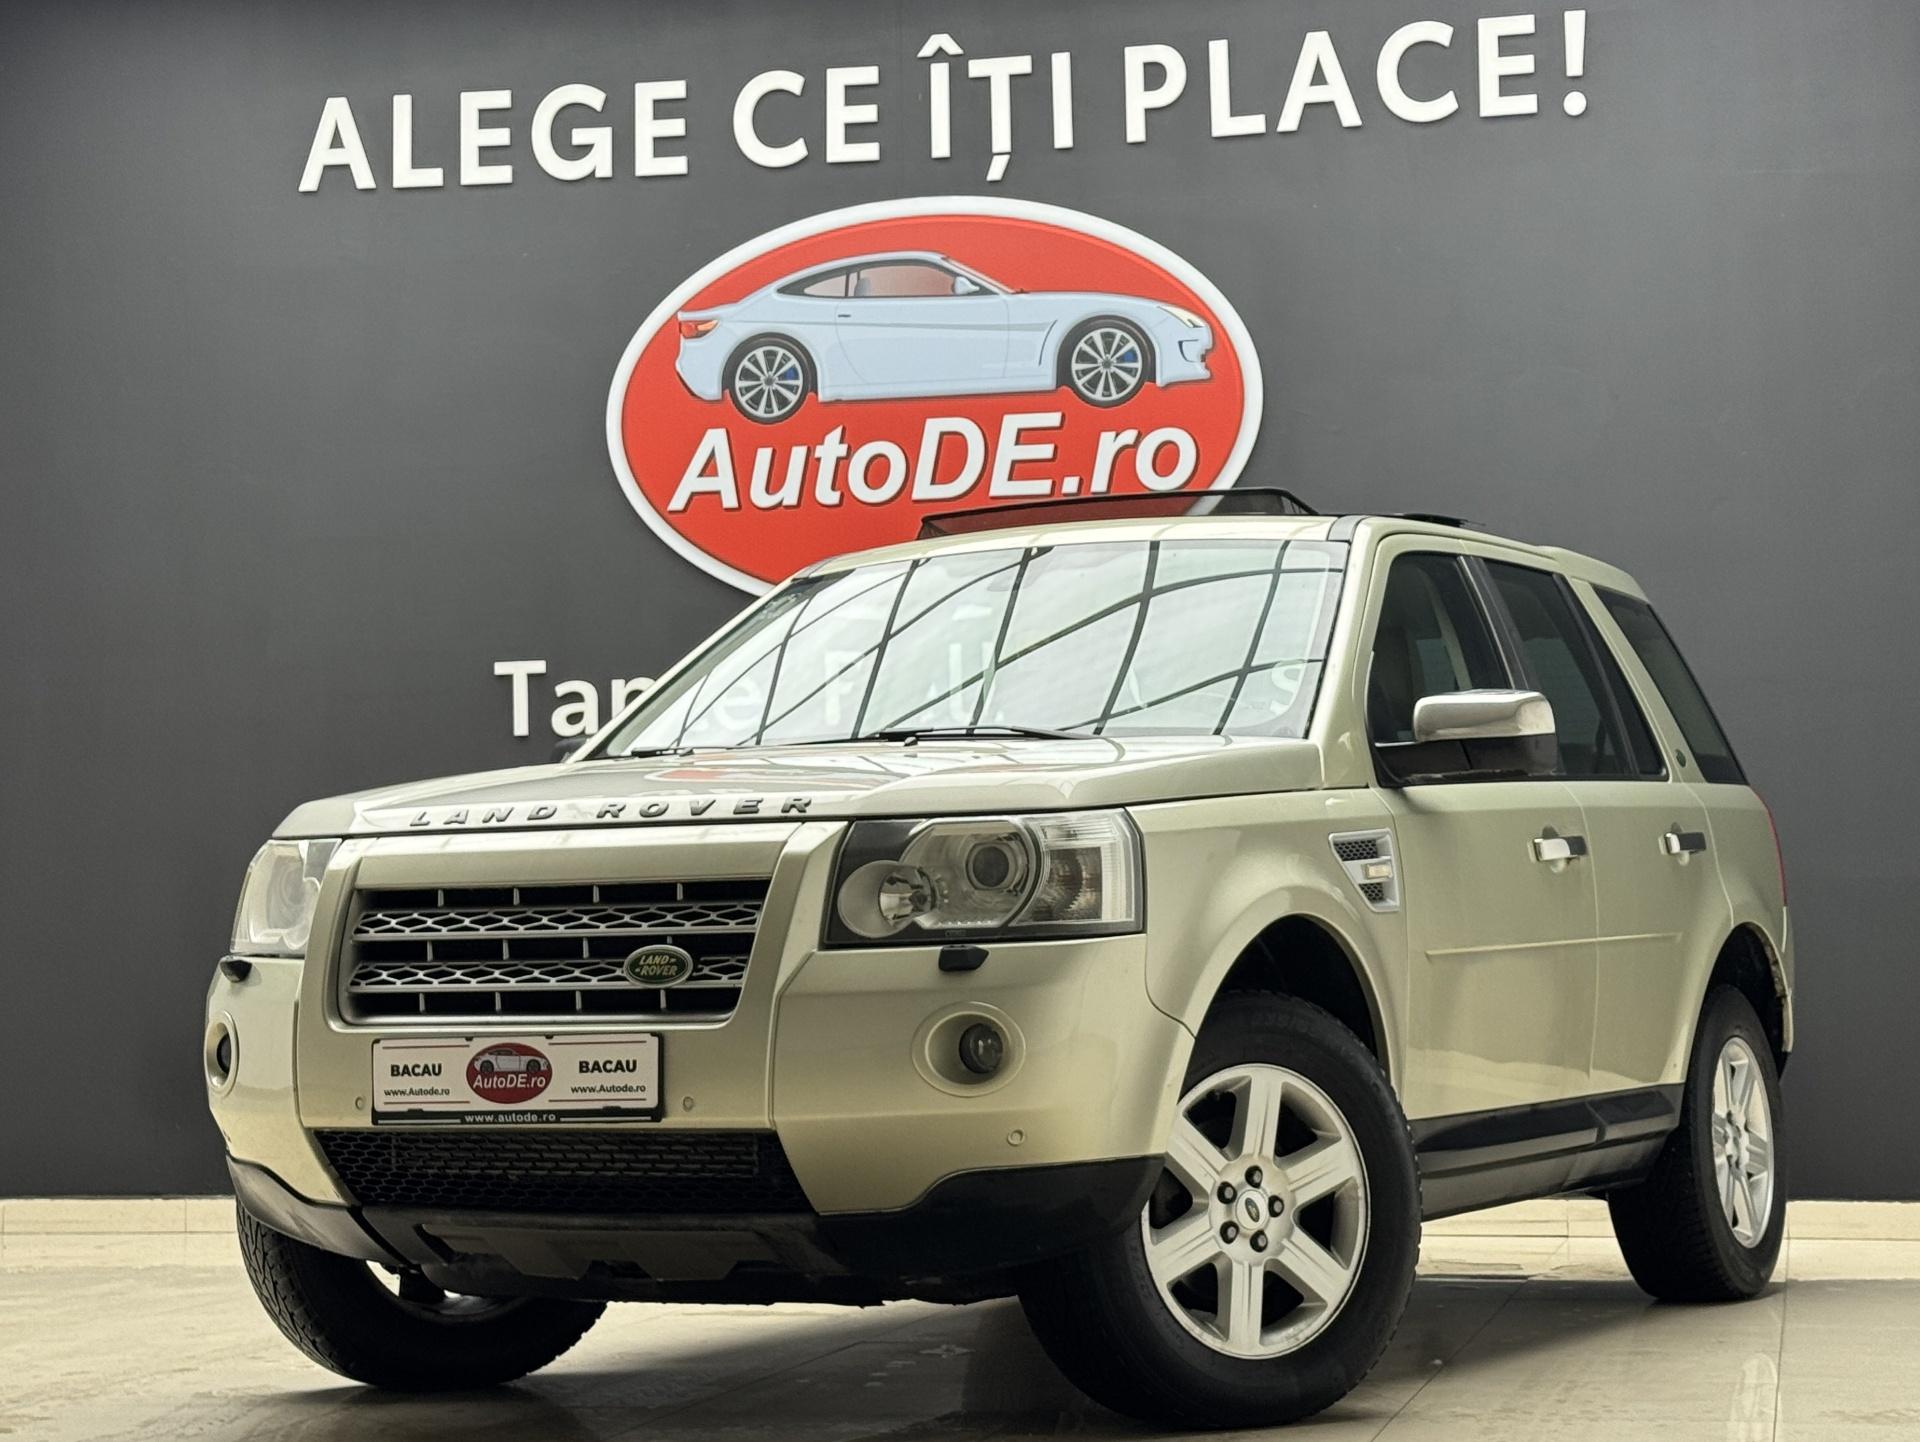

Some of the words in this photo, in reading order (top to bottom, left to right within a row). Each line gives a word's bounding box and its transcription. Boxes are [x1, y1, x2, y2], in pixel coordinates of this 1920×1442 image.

[299, 80, 688, 192] ALEGE
[732, 66, 880, 168] CE
[1124, 9, 1587, 143] PLACE!
[668, 412, 1197, 511] AutoDE.ro
[410, 806, 558, 827] LAND
[596, 797, 813, 819] ROVER
[639, 954, 670, 965] LAND
[640, 964, 678, 976] ROVER
[390, 1063, 442, 1077] BACAU
[579, 1059, 637, 1073] BACAU
[473, 1073, 546, 1089] AutoDE.ro
[384, 1086, 450, 1096] www.Autode.ro
[570, 1083, 646, 1094] www.Autode.ro
[464, 1112, 556, 1123] www.autode.ro
